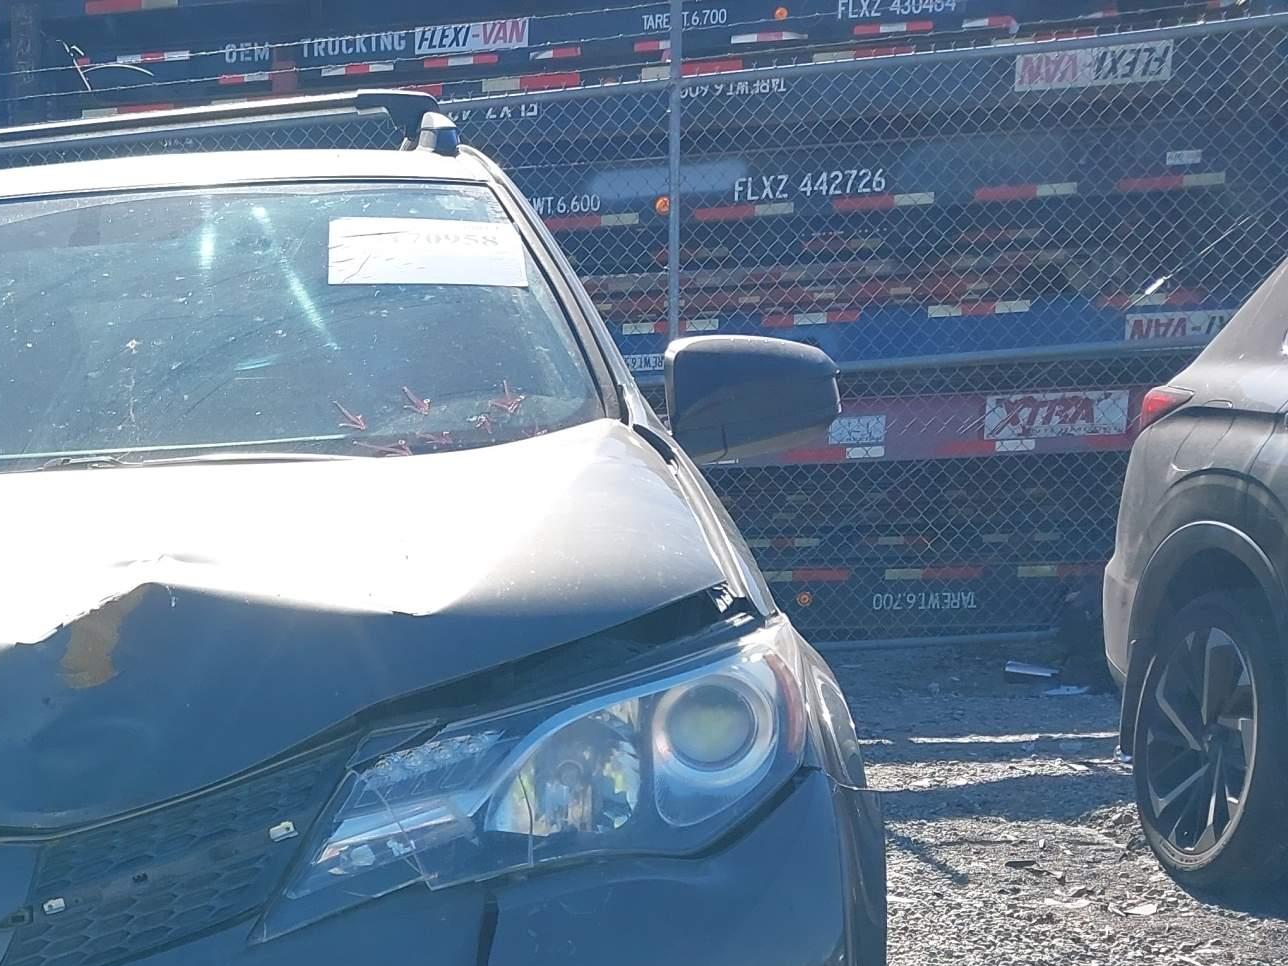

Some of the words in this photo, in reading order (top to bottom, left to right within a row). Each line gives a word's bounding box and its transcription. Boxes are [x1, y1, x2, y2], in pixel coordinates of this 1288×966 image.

[642, 13, 671, 30] TARE
[837, 0, 881, 19] FLXZ
[225, 41, 270, 64] OEM
[300, 31, 406, 58] TRUCKING
[417, 18, 527, 51] FLEXI-VAN
[734, 174, 789, 201] FLXZ
[798, 168, 886, 197] 442726
